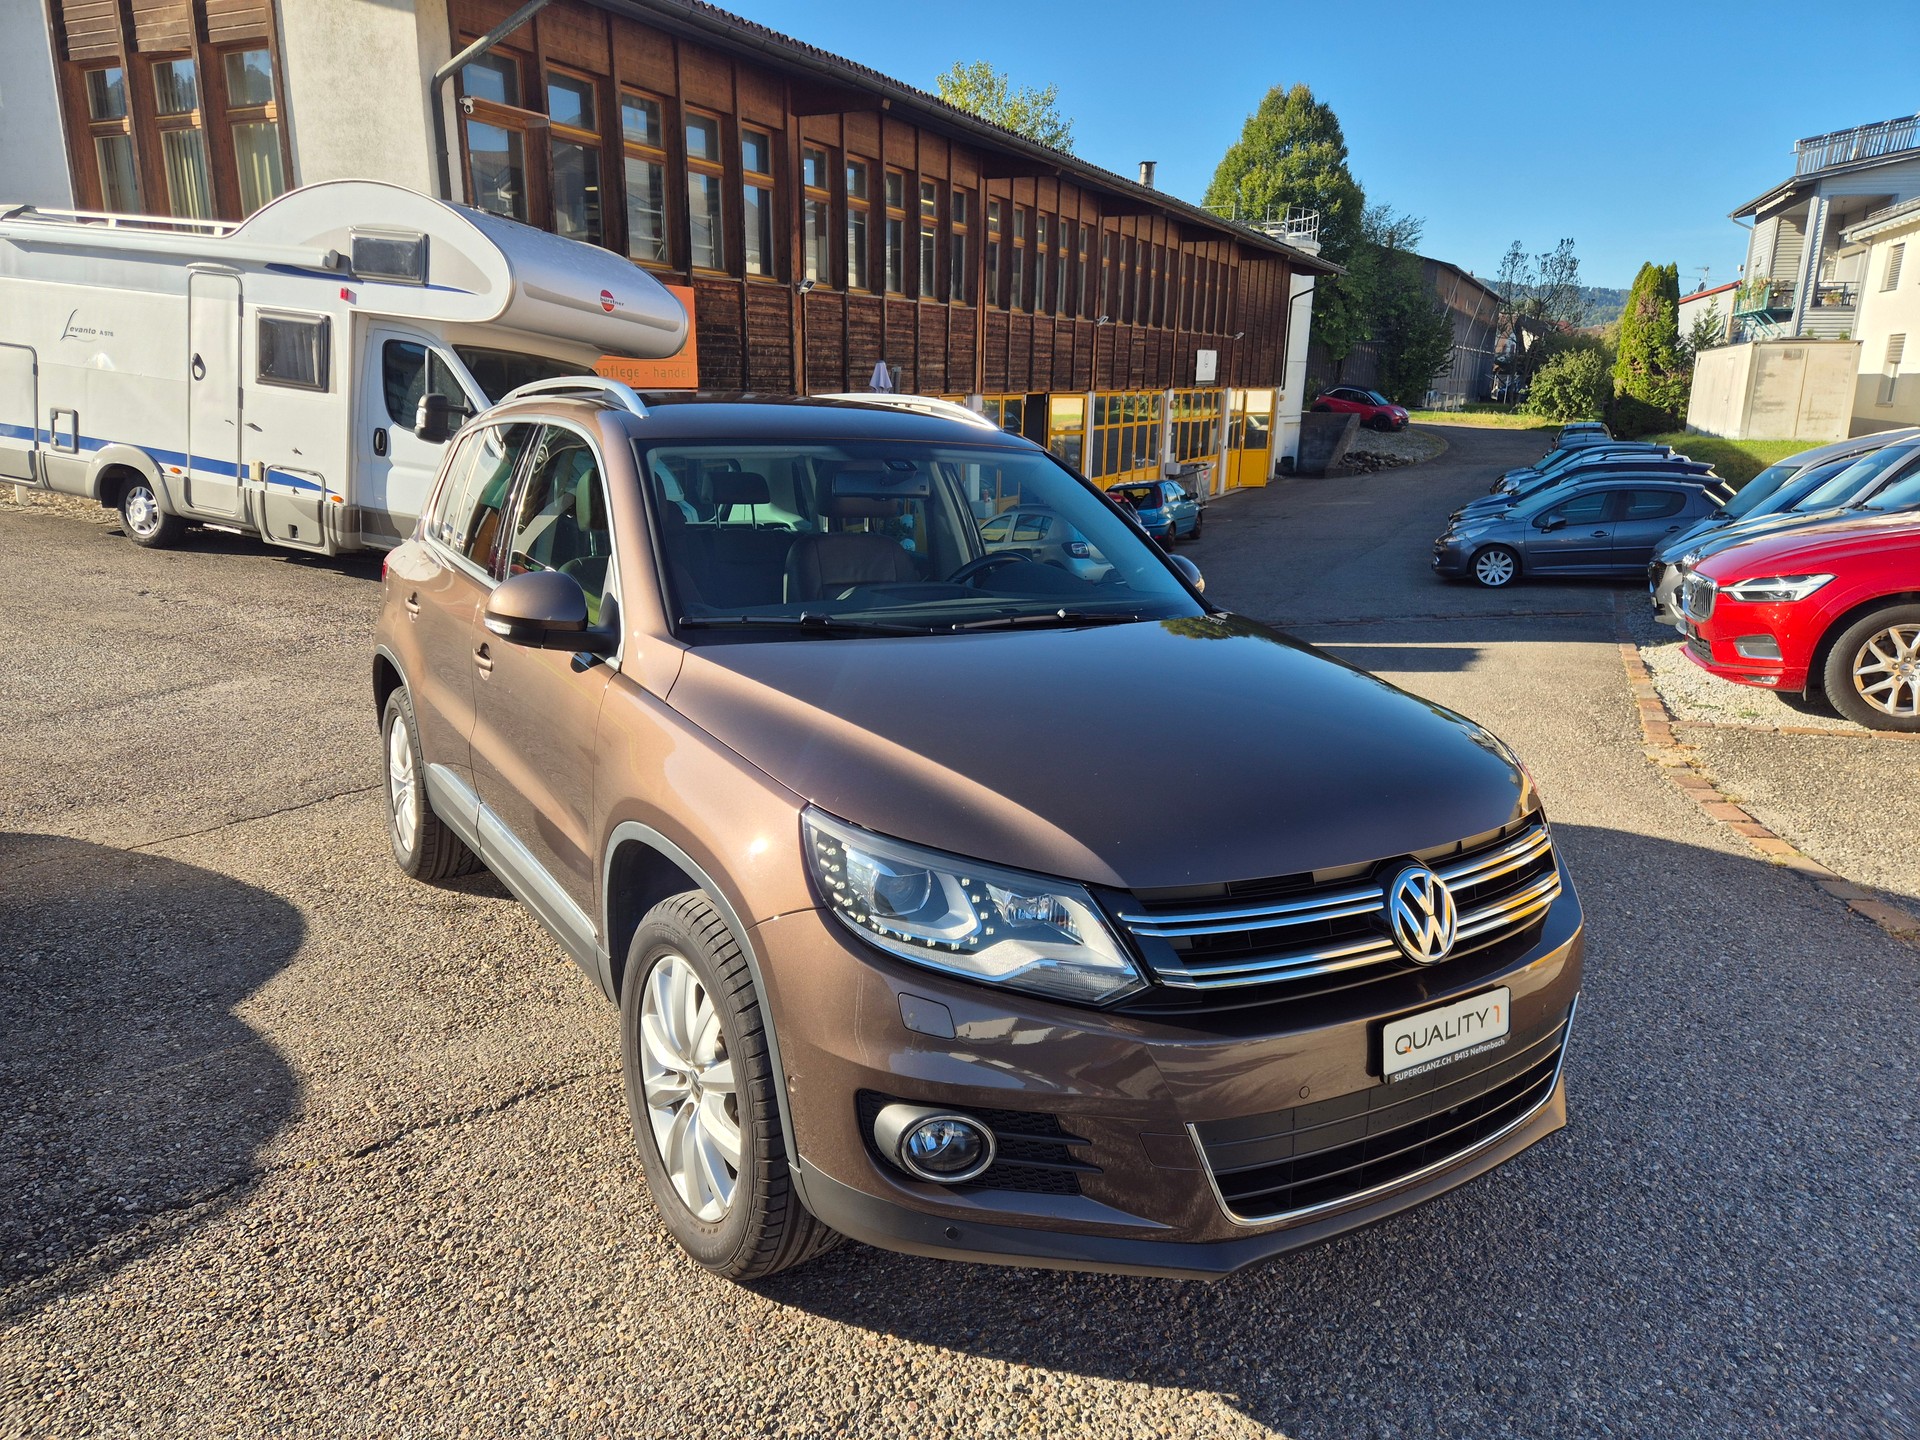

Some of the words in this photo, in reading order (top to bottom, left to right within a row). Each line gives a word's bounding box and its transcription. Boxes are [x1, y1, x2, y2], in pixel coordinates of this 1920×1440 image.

[60, 308, 97, 341] Levanto
[653, 366, 691, 378] handel
[1394, 1056, 1452, 1082] SUPERGLANZ.CH
[1454, 1050, 1469, 1062] 8413
[1470, 1039, 1506, 1056] Neftenbach
